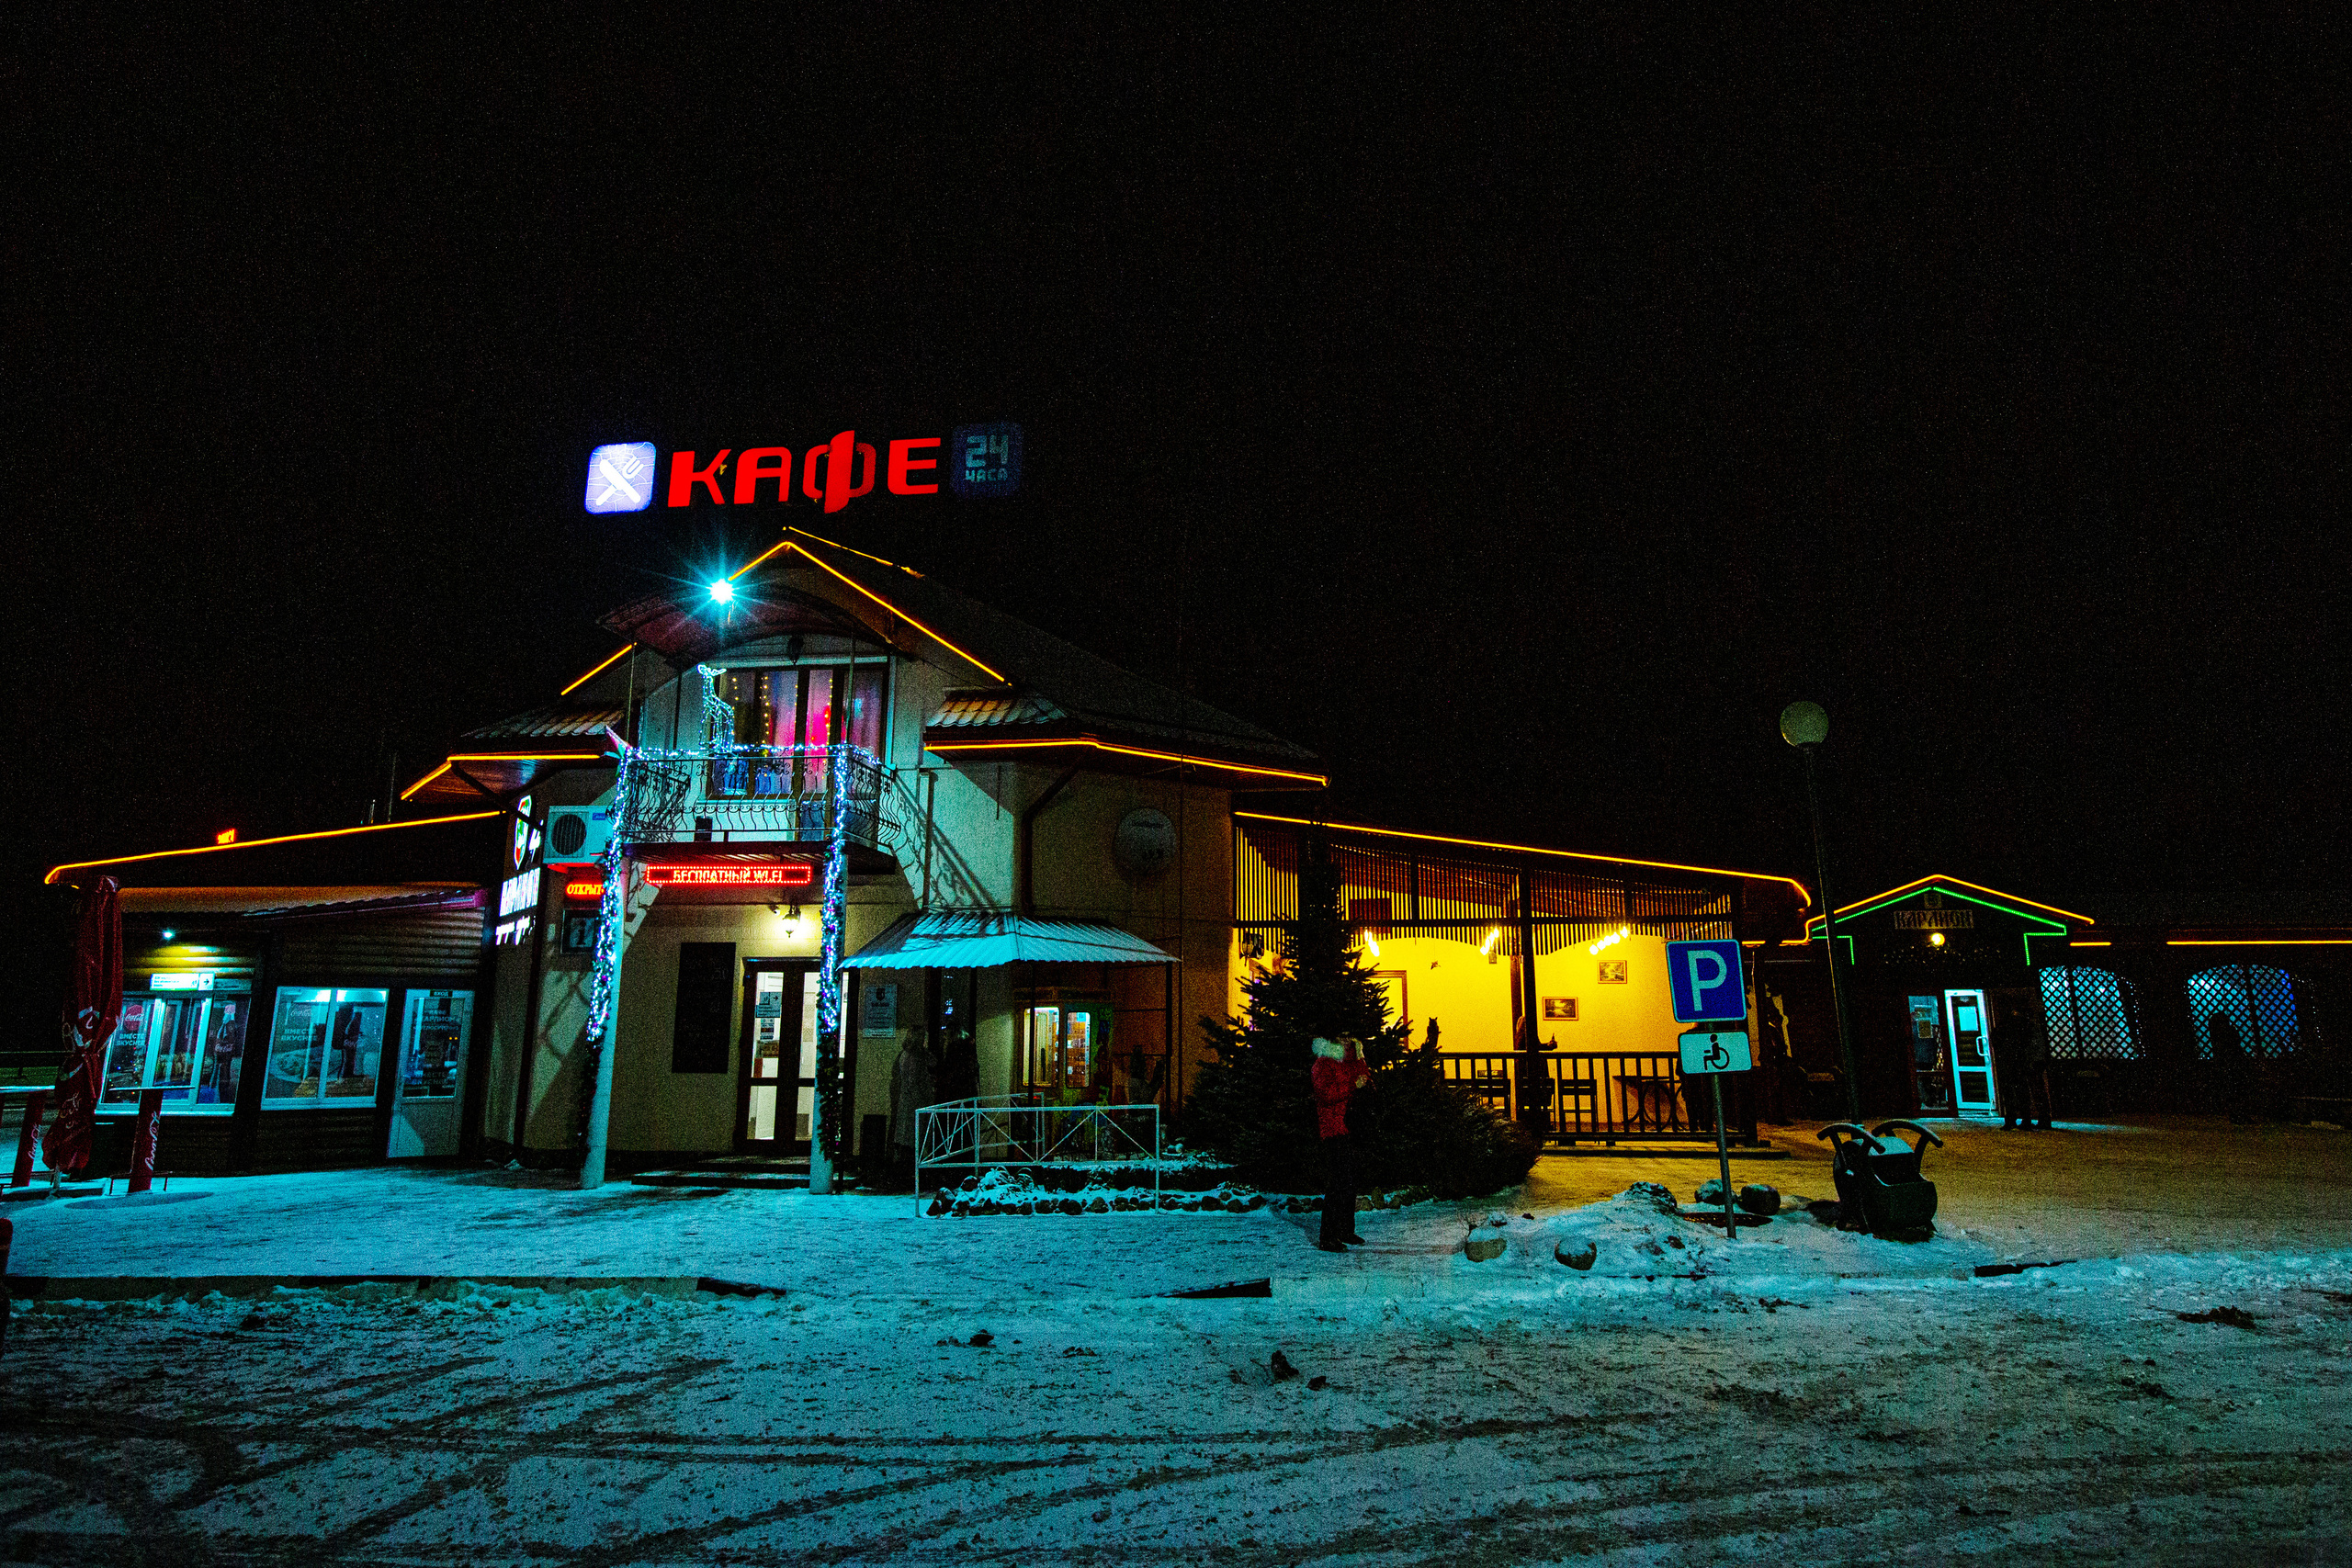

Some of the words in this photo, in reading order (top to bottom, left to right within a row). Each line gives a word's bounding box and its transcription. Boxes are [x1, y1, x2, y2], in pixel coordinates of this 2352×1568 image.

[668, 431, 941, 513] КАФЕ
[966, 434, 1009, 468] 24
[966, 468, 1008, 482] ЧАСА
[1688, 950, 1727, 1011] P
